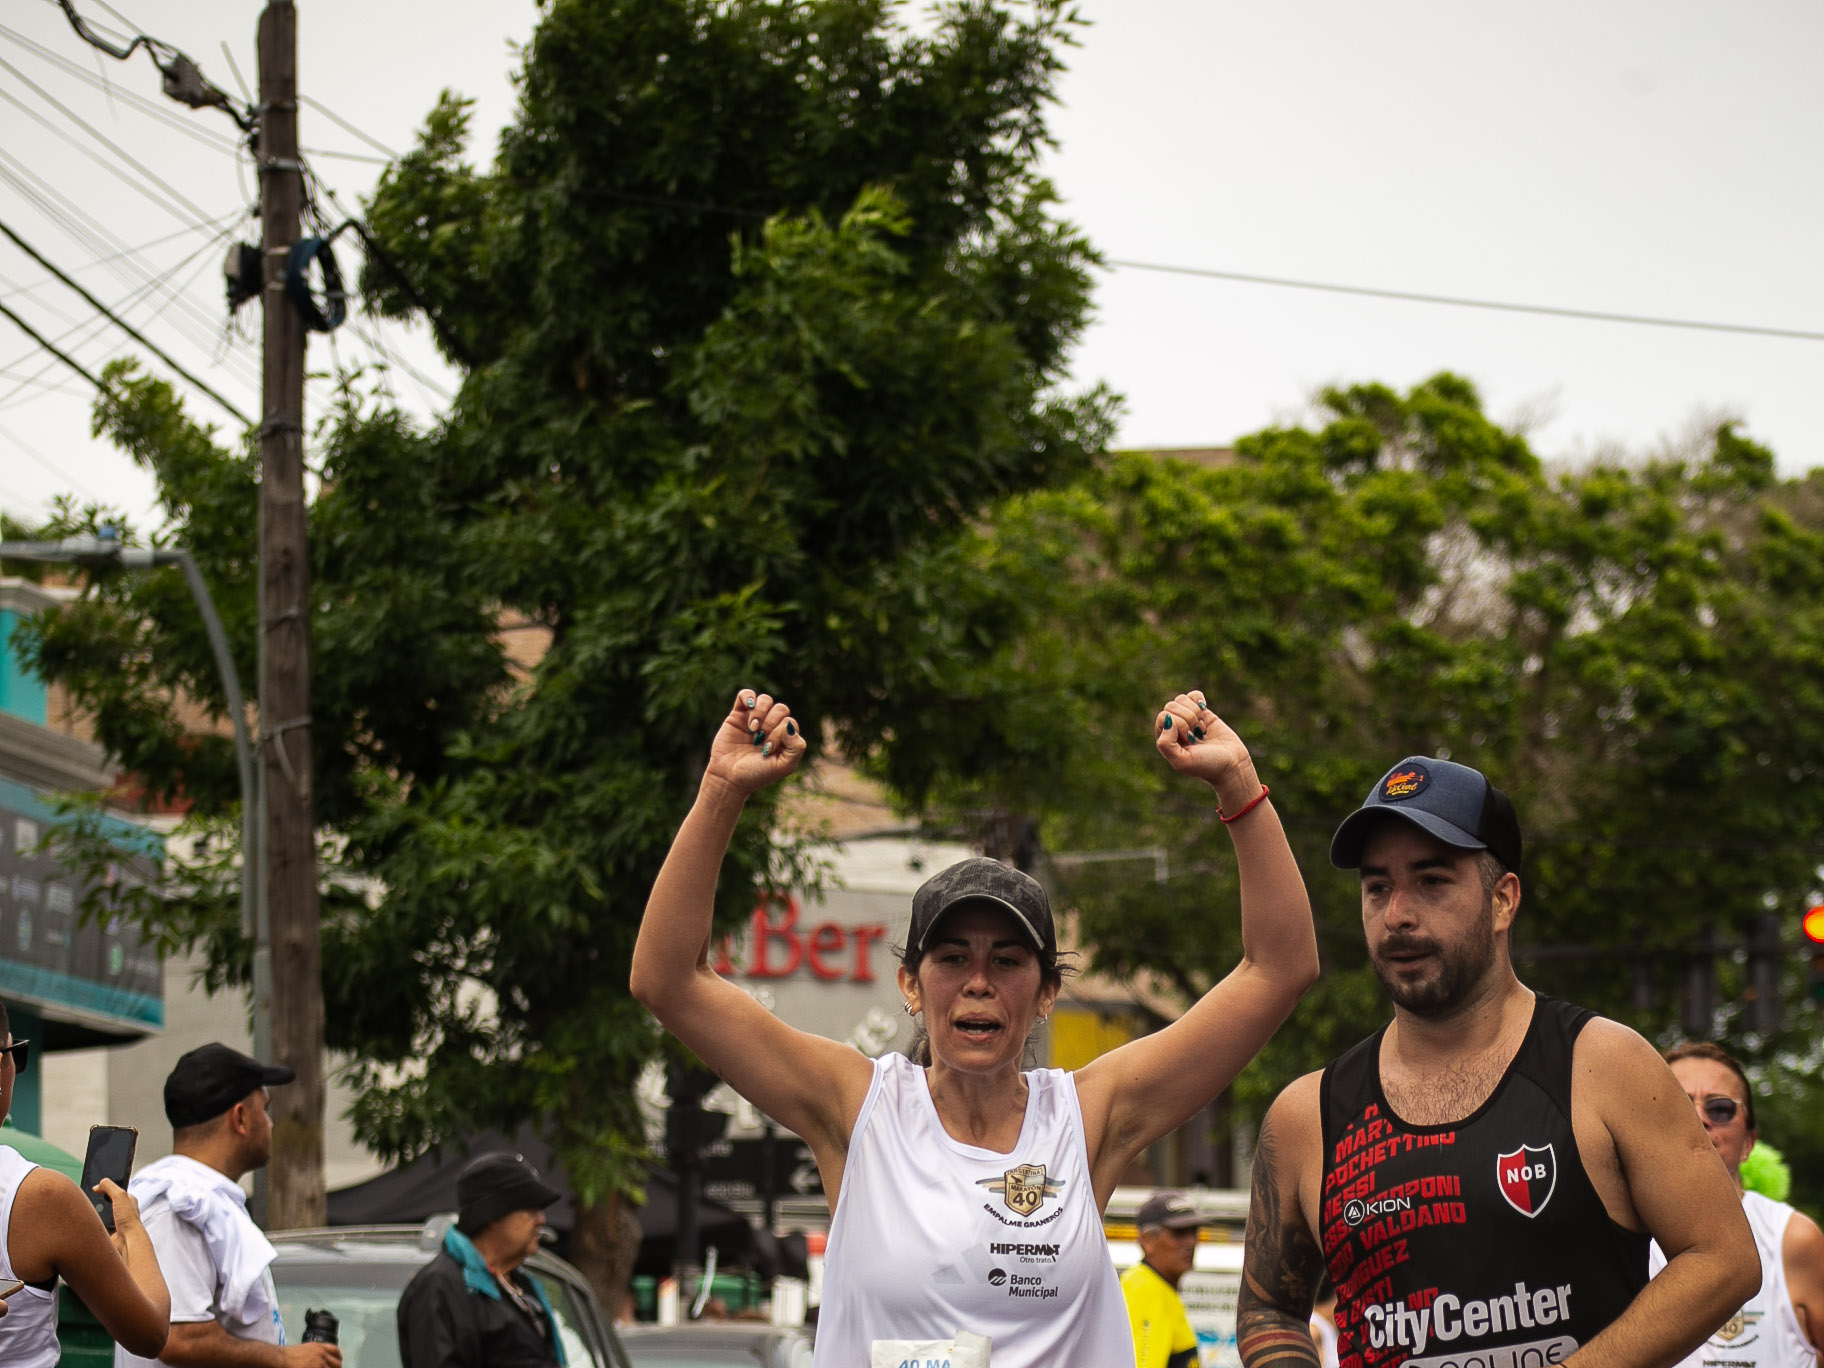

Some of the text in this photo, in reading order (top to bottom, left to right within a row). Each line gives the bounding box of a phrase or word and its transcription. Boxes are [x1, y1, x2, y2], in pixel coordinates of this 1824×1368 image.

[1507, 1164, 1547, 1184] NOB
[1012, 1191, 1038, 1206] 40
[984, 1203, 1064, 1228] EMPALME GRANEROS
[1360, 1202, 1466, 1250] VALDANO
[1010, 1274, 1042, 1286] Banco
[1008, 1286, 1059, 1300] Municipal
[1364, 1281, 1572, 1356] CityCenter
